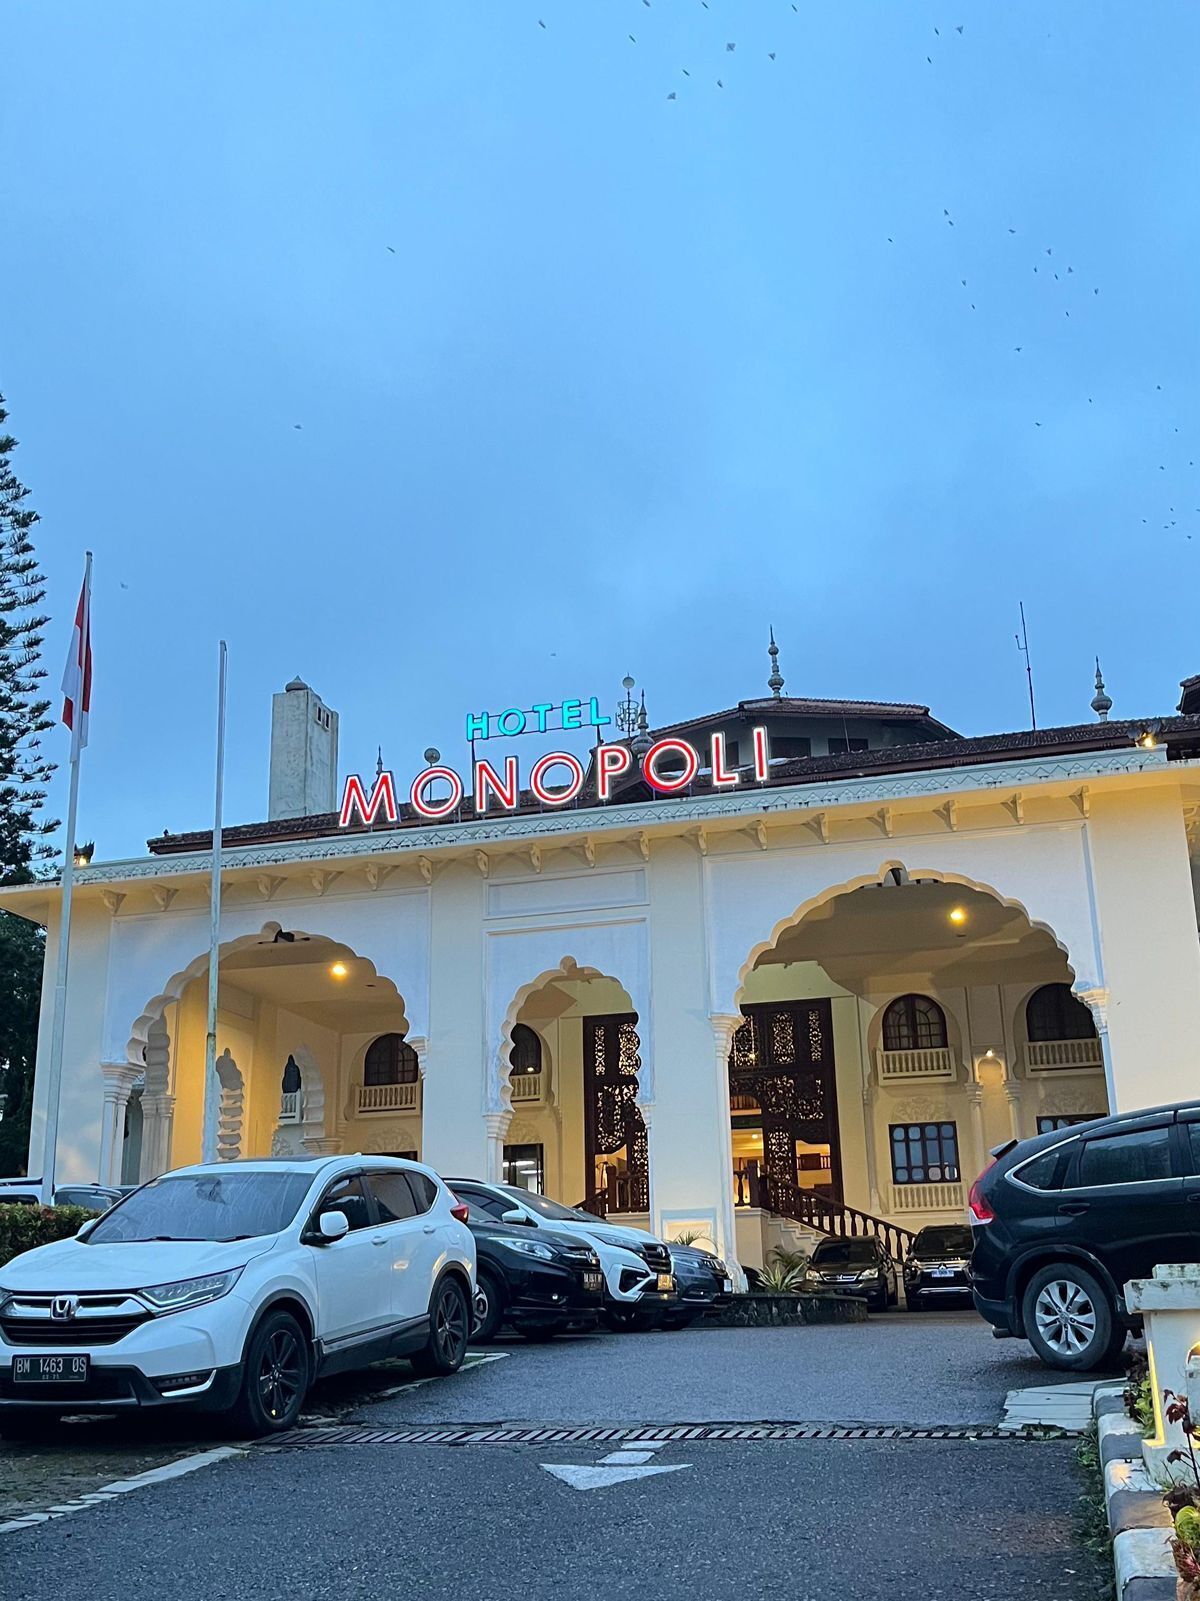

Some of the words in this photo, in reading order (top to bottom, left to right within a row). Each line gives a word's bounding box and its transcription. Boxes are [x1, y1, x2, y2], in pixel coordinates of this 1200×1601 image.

[466, 697, 612, 741] HOTEL
[339, 727, 769, 826] MONOPOLI
[16, 1358, 31, 1373] BM
[39, 1358, 62, 1373] 1463
